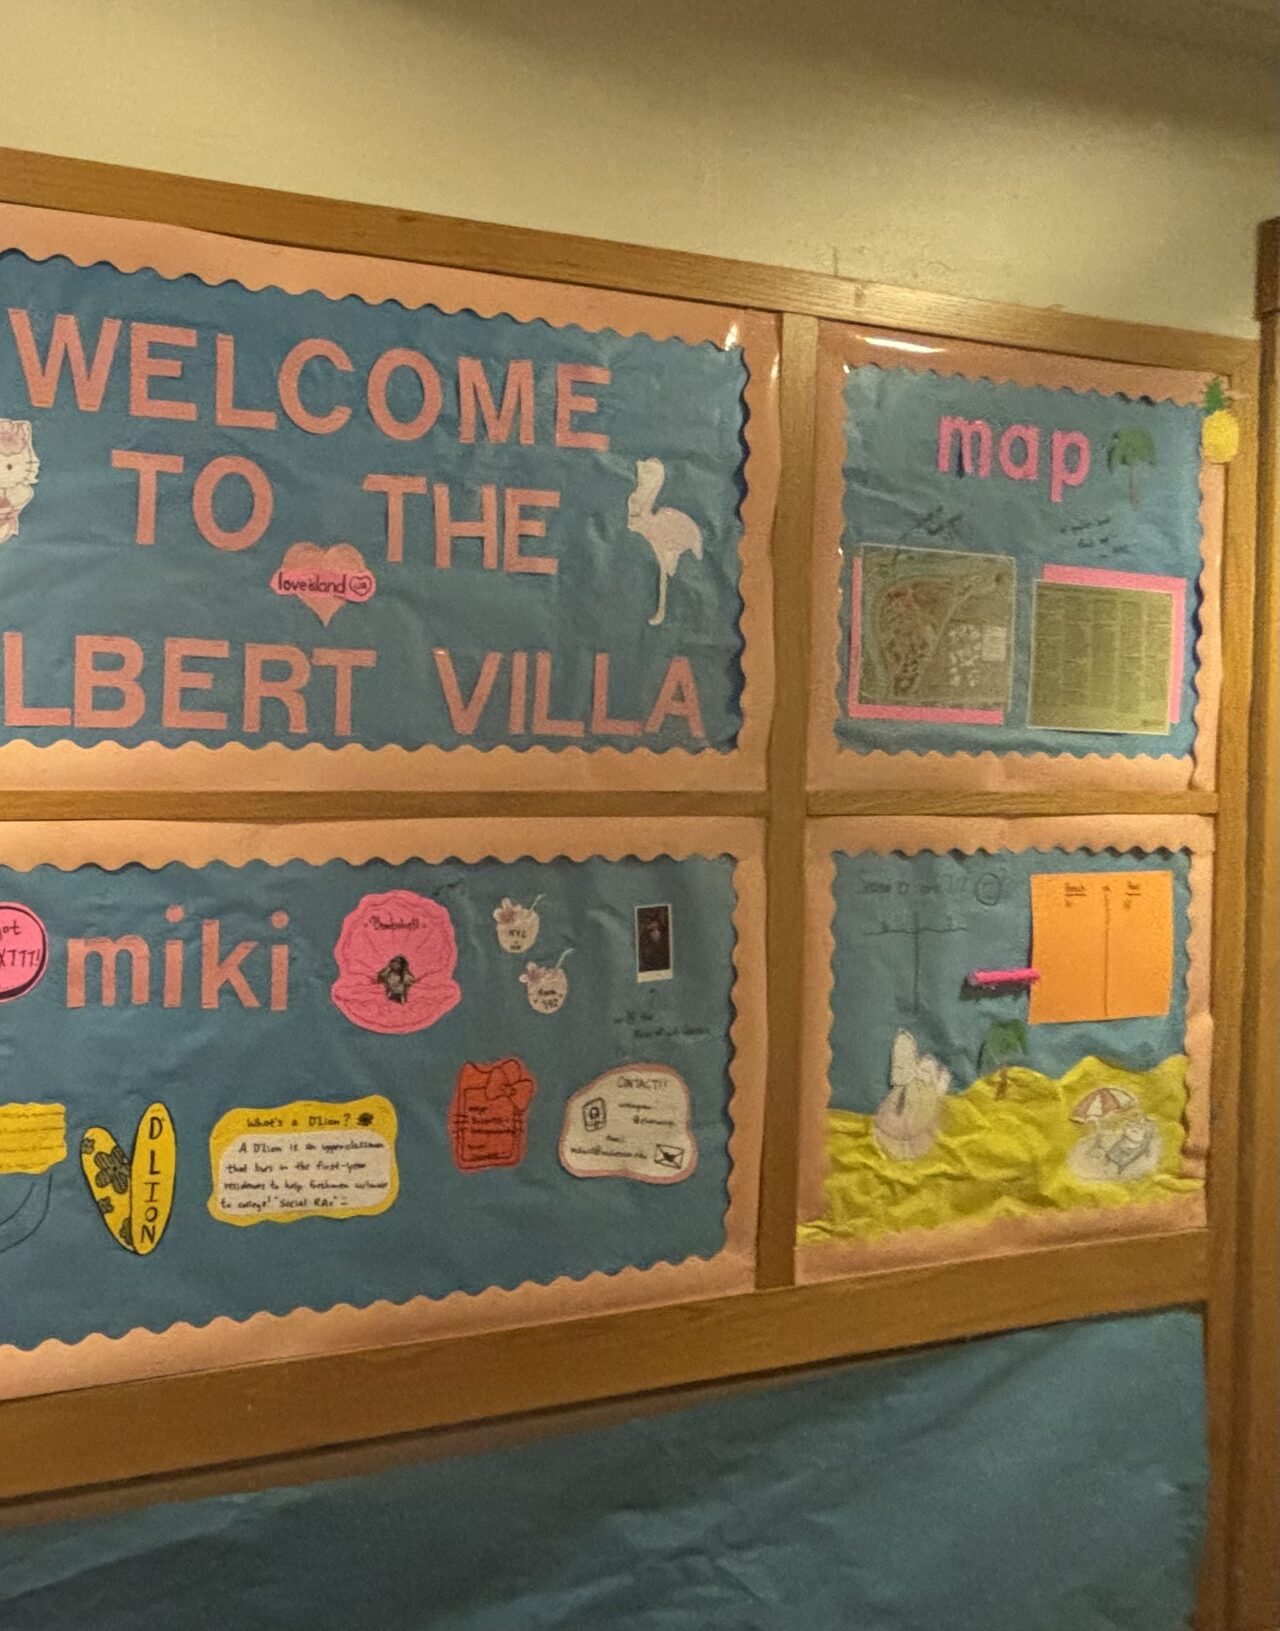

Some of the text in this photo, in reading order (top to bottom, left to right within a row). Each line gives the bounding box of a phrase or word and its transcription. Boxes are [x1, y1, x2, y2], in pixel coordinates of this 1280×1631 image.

[8, 308, 612, 452] WELCOME
[937, 415, 1093, 503] map
[111, 449, 560, 575] TO THE
[433, 645, 706, 740] VILLA
[65, 904, 290, 1012] miki
[238, 1141, 248, 1154] A
[289, 1143, 299, 1153] is
[291, 1118, 299, 1128] a
[220, 1196, 232, 1209] to
[269, 1179, 280, 1190] to
